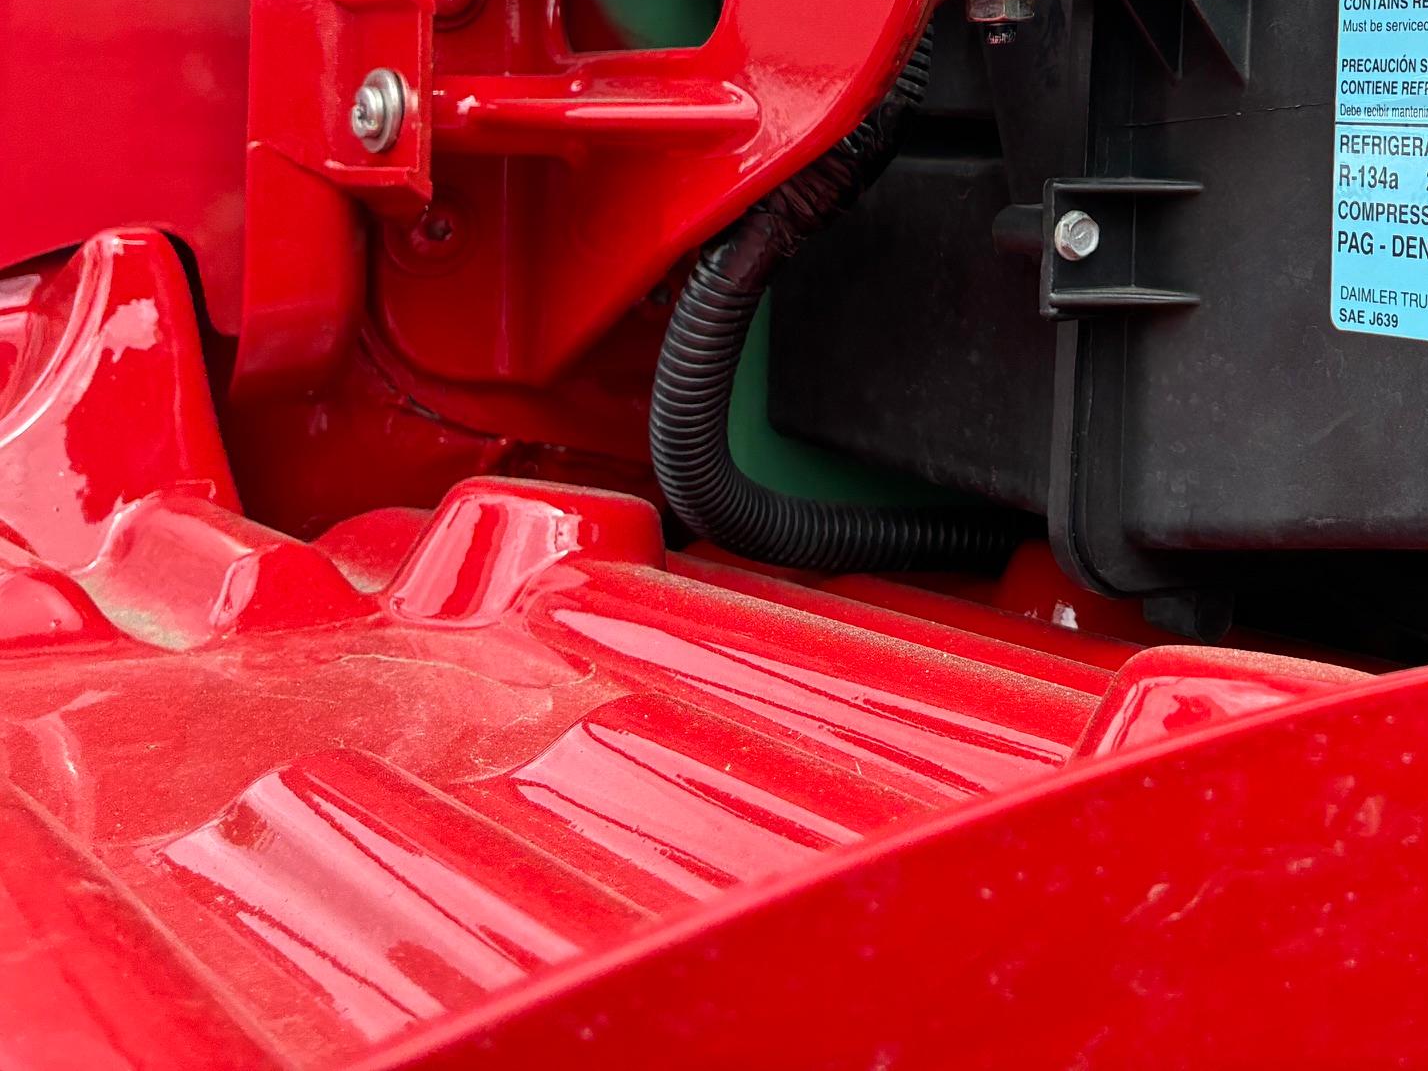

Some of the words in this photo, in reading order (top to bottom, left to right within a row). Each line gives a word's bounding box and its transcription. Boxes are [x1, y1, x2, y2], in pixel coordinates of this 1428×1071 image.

[1343, 19, 1367, 32] Must
[1370, 19, 1383, 31] be
[1342, 55, 1416, 73] PRECAUCIÓN
[1341, 81, 1397, 95] CONTIENE
[1340, 104, 1361, 116] Debe
[1364, 104, 1389, 116] recibir
[1339, 165, 1399, 190] R-134a
[1338, 231, 1373, 255] PAG
[1341, 286, 1397, 306] DAIMLER
[1339, 308, 1364, 324] SAE
[1369, 312, 1398, 328] J639
